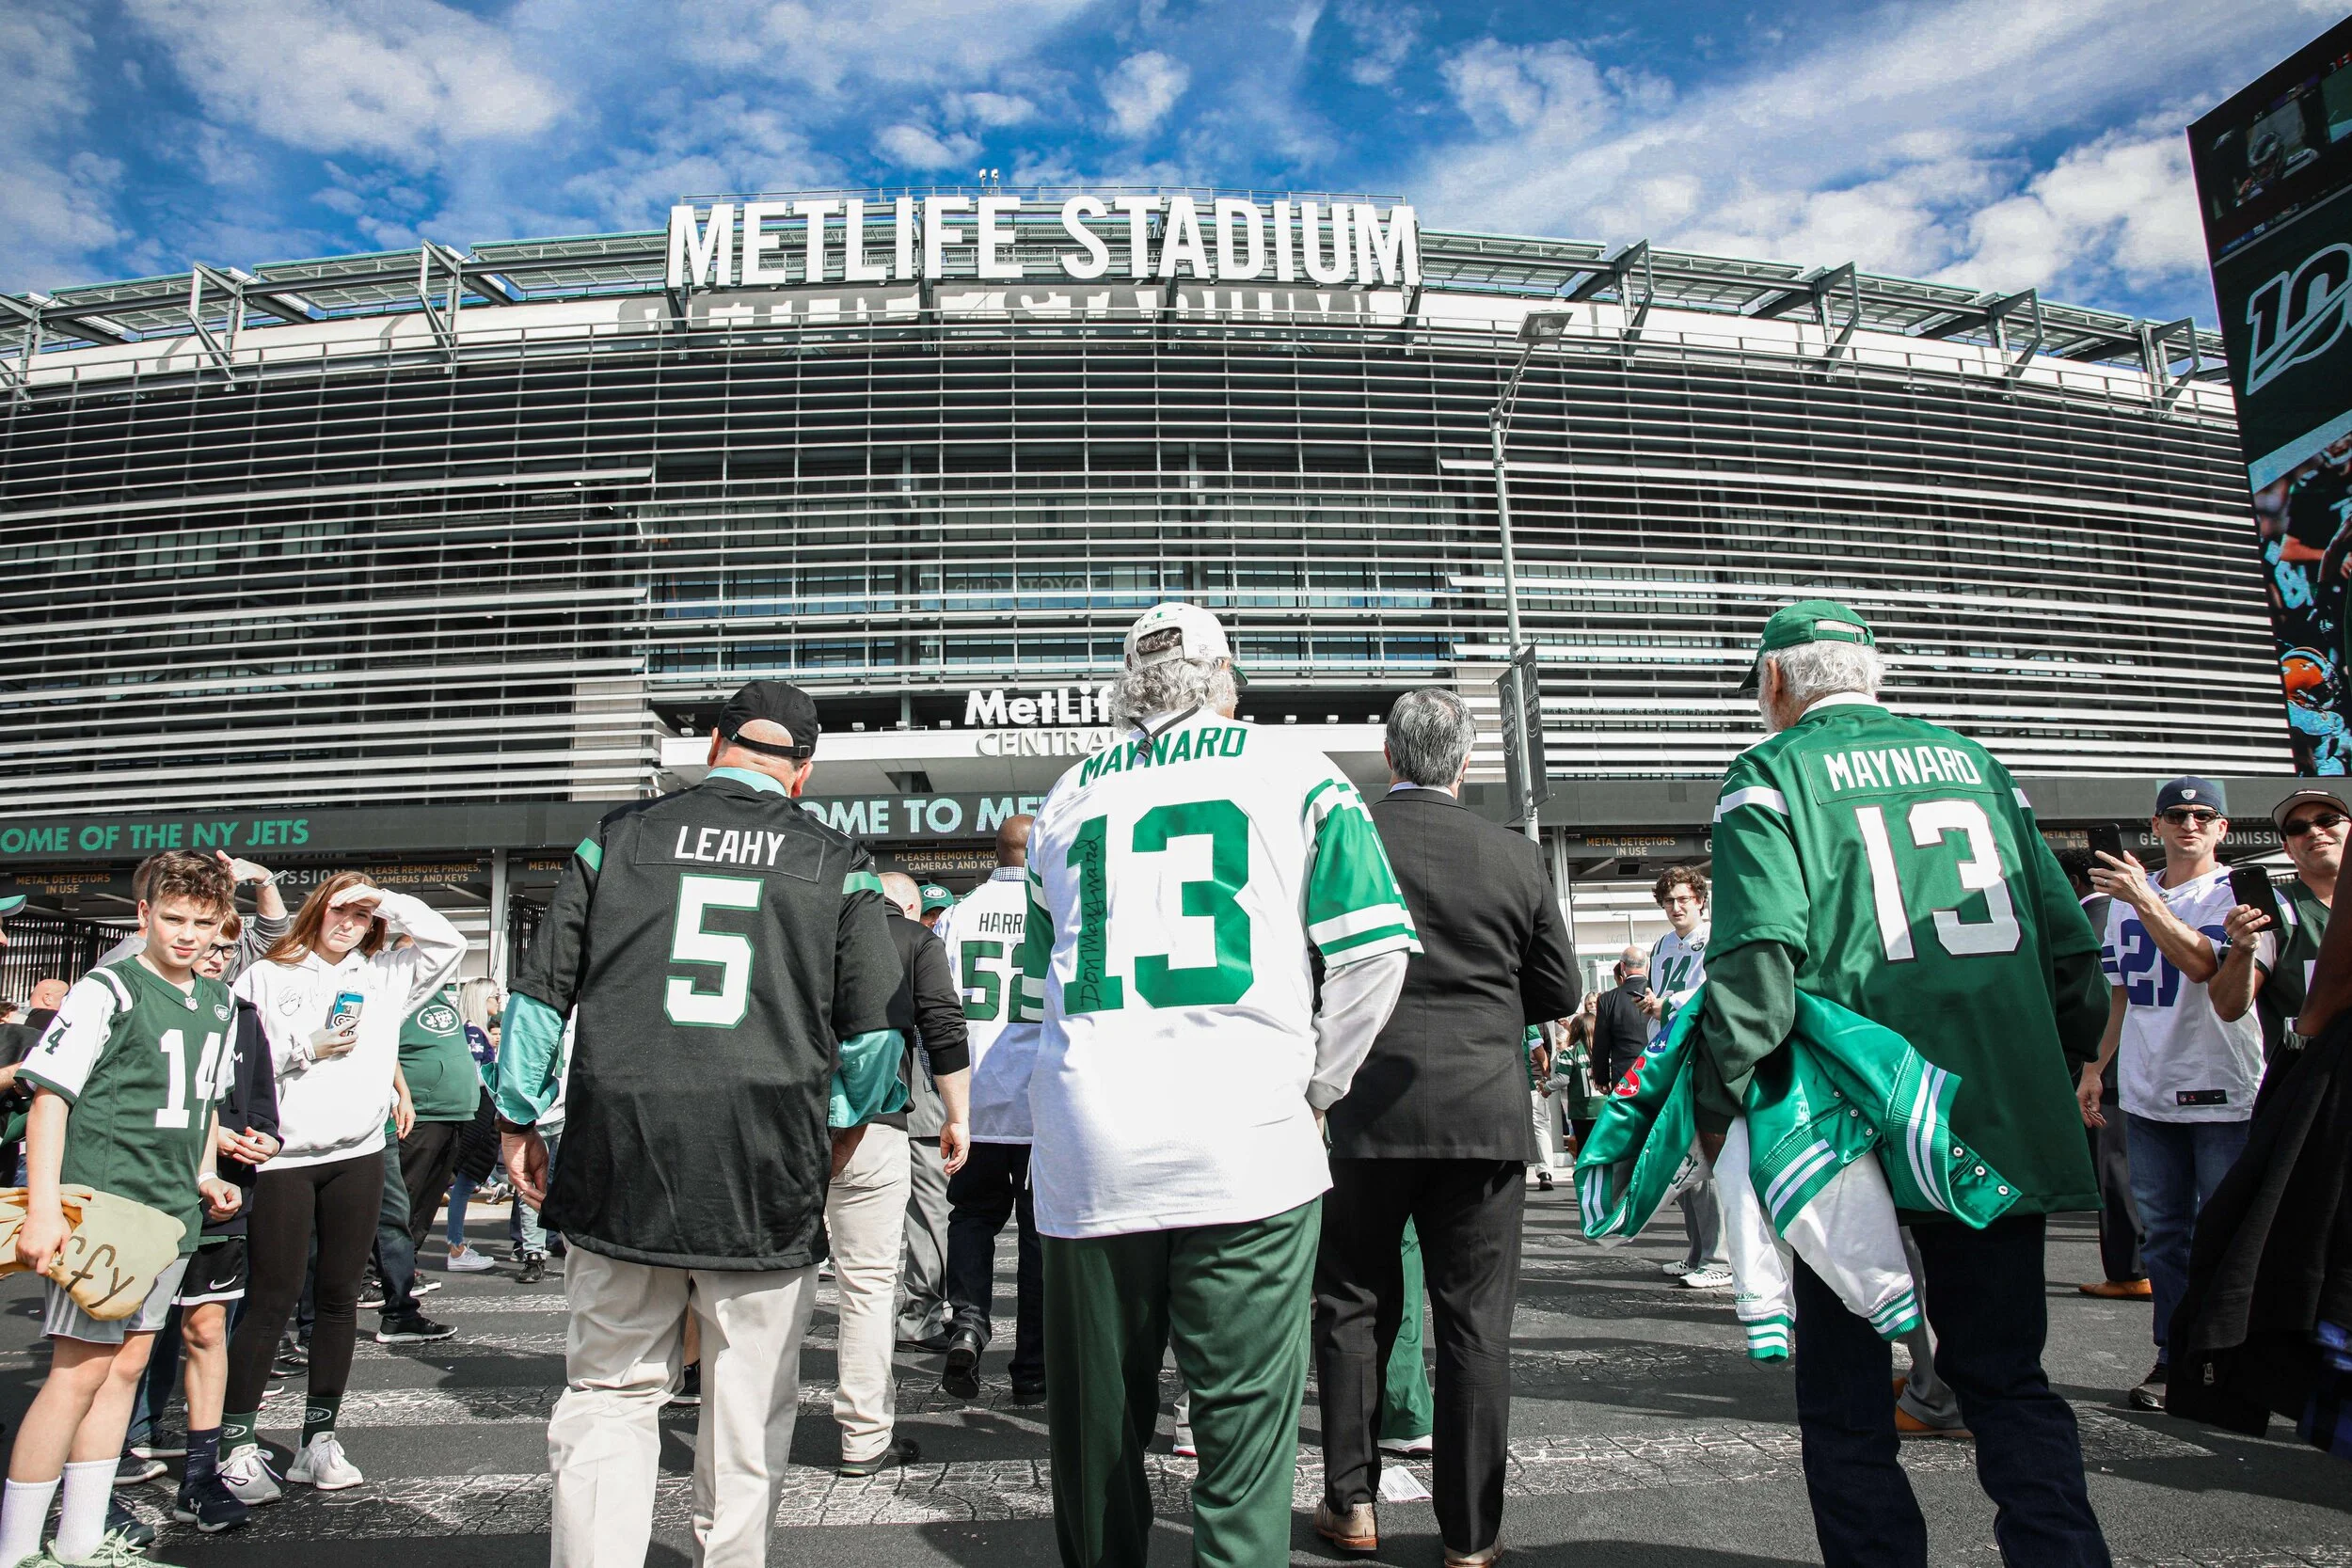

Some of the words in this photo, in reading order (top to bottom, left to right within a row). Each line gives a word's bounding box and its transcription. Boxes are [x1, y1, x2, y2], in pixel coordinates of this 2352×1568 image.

[669, 196, 1023, 288] METLIFE
[1061, 195, 1422, 285] STADIUM
[1079, 727, 1248, 787] MAYNARD
[1823, 746, 1982, 792] MAYNARD
[903, 798, 962, 833] TO
[79, 826, 120, 851] OF
[130, 824, 183, 848] THE
[193, 821, 240, 847] NY
[246, 818, 309, 846] JETS
[674, 825, 786, 866] LEAHY
[1586, 838, 1618, 847] METAL
[1621, 837, 1676, 846] DETECTORS
[1616, 847, 1627, 856] IN
[1629, 847, 1647, 856] USE
[364, 866, 400, 876] PLEASE
[402, 864, 438, 874] REMOVE
[529, 861, 564, 871] METAL
[895, 853, 930, 862] PLEASE
[934, 851, 973, 861] REMOVE
[908, 861, 954, 870] CAMERAS
[957, 861, 977, 869] AND
[16, 876, 49, 885] METAL
[52, 874, 111, 884] DETECTORS
[45, 886, 56, 895] IN
[59, 884, 80, 894] USE
[376, 875, 420, 884] CAMERAS
[422, 874, 442, 883] AND
[445, 873, 469, 882] KEYS
[1854, 799, 2022, 964] 13
[1064, 799, 1254, 1015] 13
[663, 874, 764, 1029] 5
[1657, 955, 1692, 998] 14
[155, 1028, 222, 1130] 14
